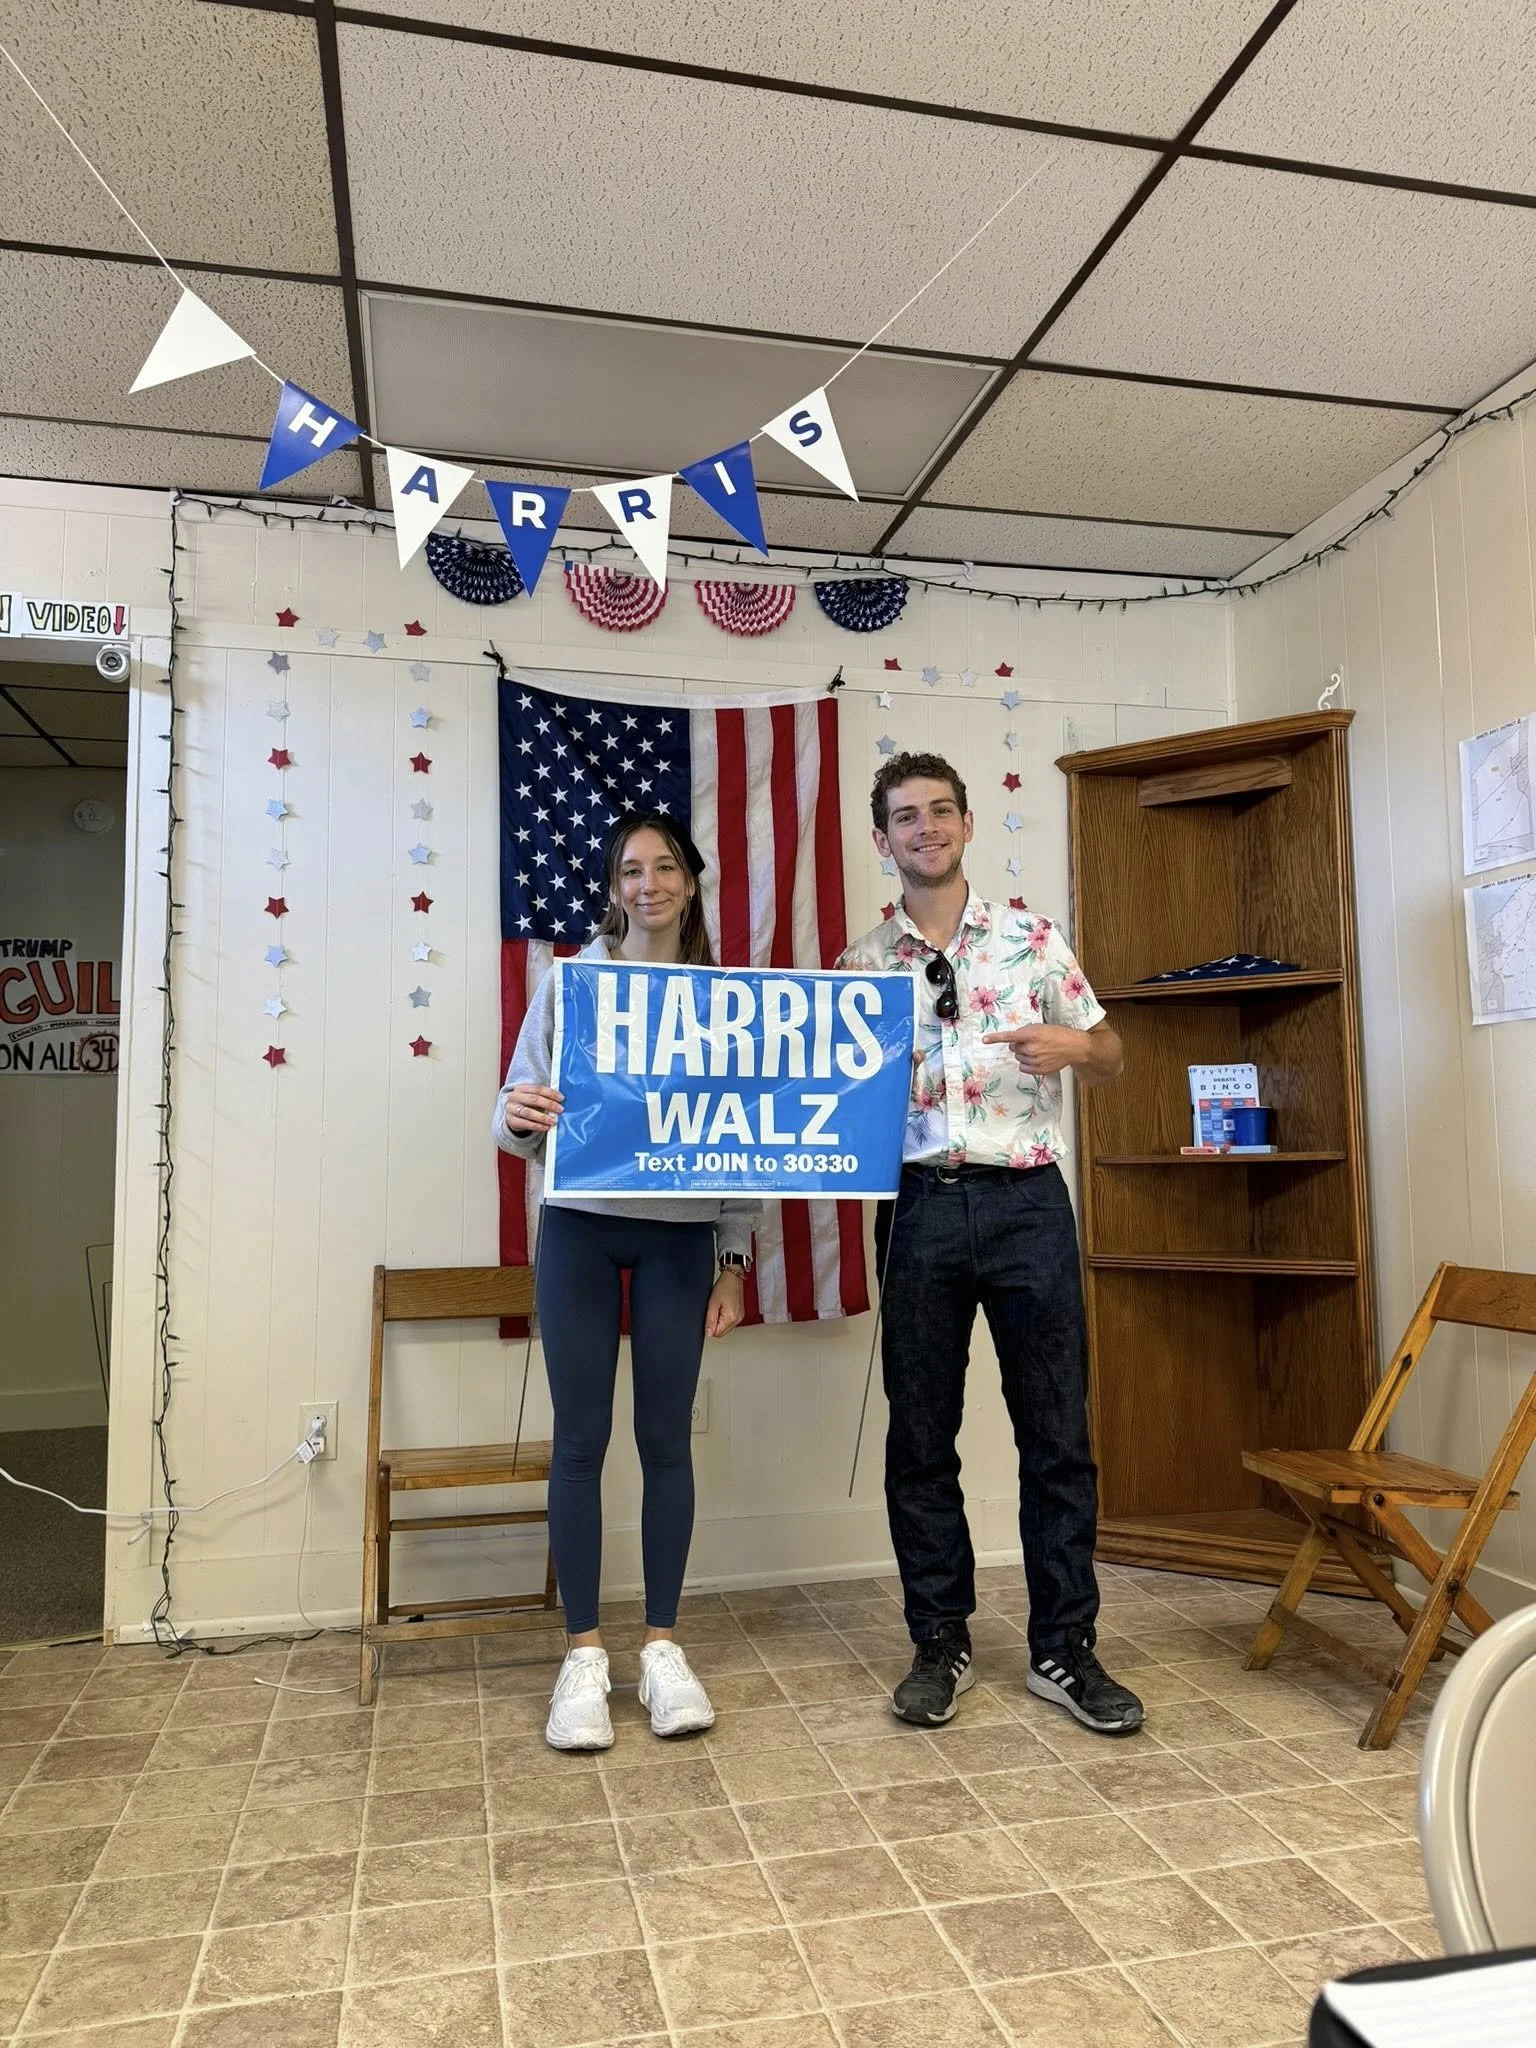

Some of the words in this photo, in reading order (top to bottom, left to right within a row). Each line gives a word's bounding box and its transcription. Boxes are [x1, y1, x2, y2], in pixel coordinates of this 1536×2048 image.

[288, 401, 823, 529] HARRIS
[27, 601, 111, 634] VIDEO
[0, 938, 73, 958] TRUMP
[596, 972, 884, 1080] HARRIS
[0, 1041, 34, 1071] ON
[39, 1042, 81, 1071] ALL
[85, 1038, 116, 1071] 34
[1200, 1083, 1252, 1091] BINGO
[644, 1092, 839, 1146] WALZ
[635, 1152, 686, 1172] Text
[691, 1152, 748, 1172] JOIN
[754, 1154, 778, 1173] to
[783, 1154, 858, 1173] 30330
